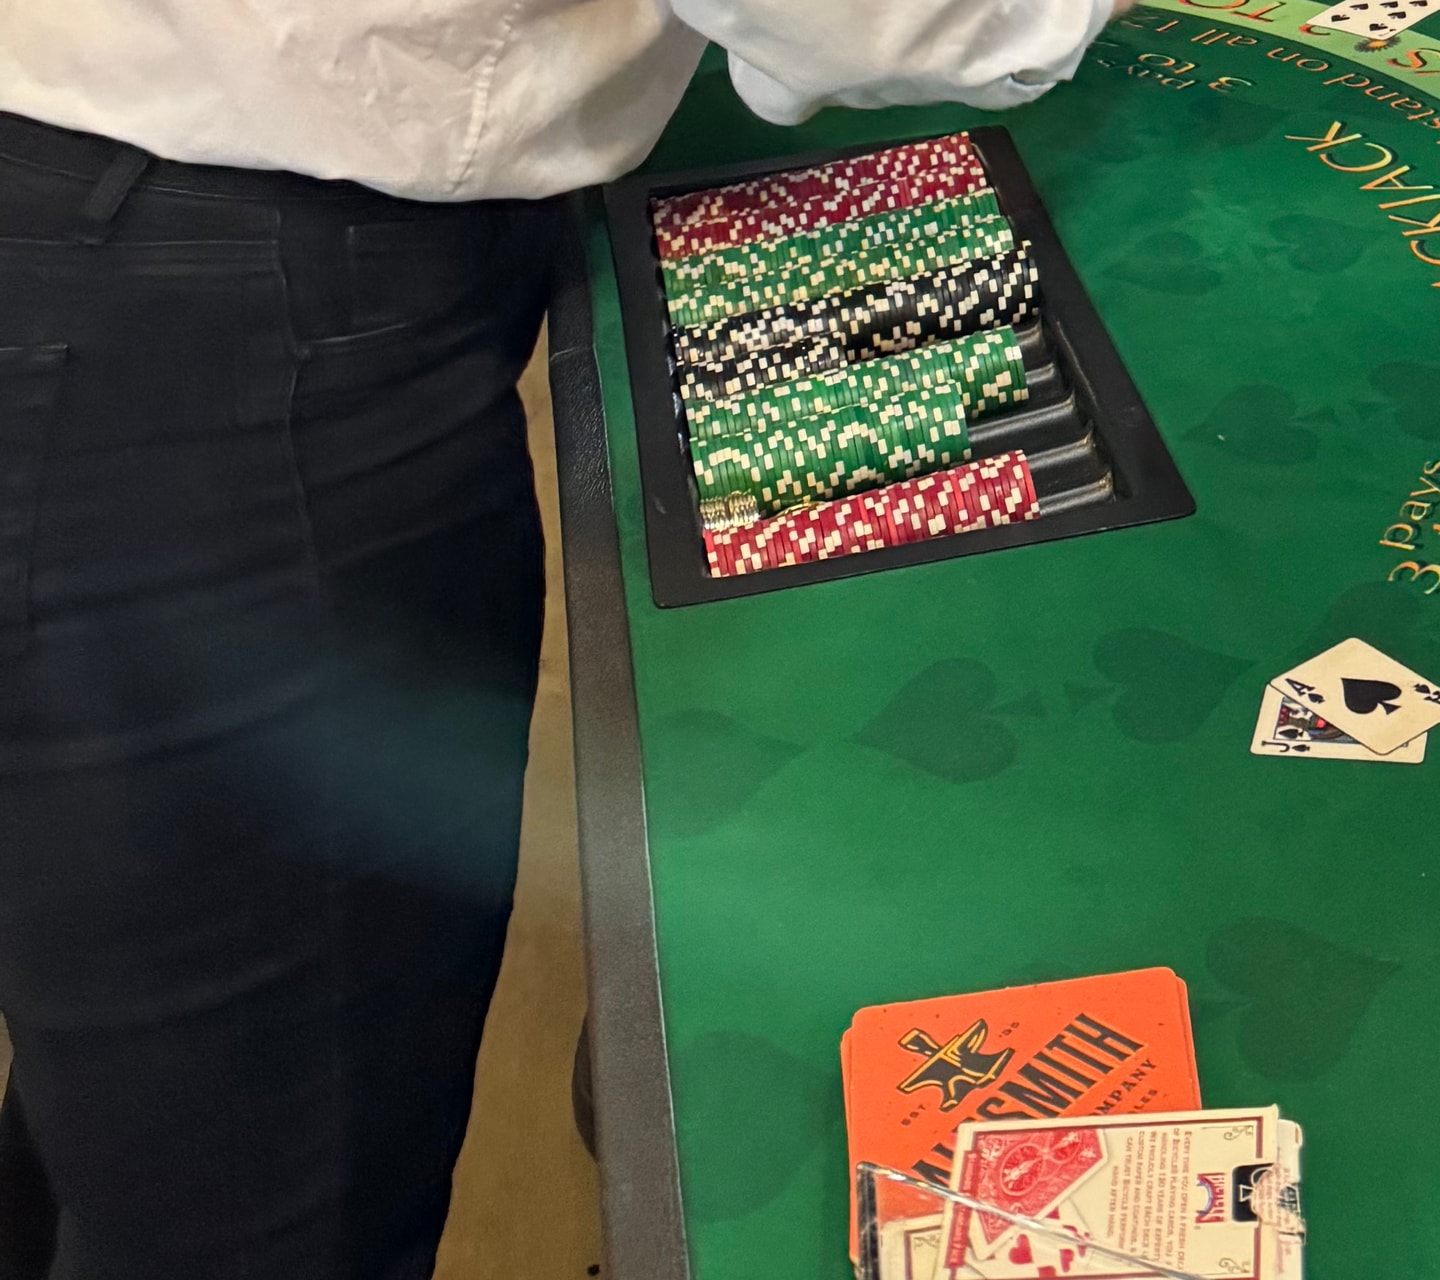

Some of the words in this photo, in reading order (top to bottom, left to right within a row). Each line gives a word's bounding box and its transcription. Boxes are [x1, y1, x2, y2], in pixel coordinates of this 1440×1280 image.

[1191, 28, 1258, 48] all
[1266, 46, 1330, 73] on
[1284, 677, 1316, 697] A
[1261, 740, 1290, 753] J
[1089, 1058, 1158, 1117] MPANY
